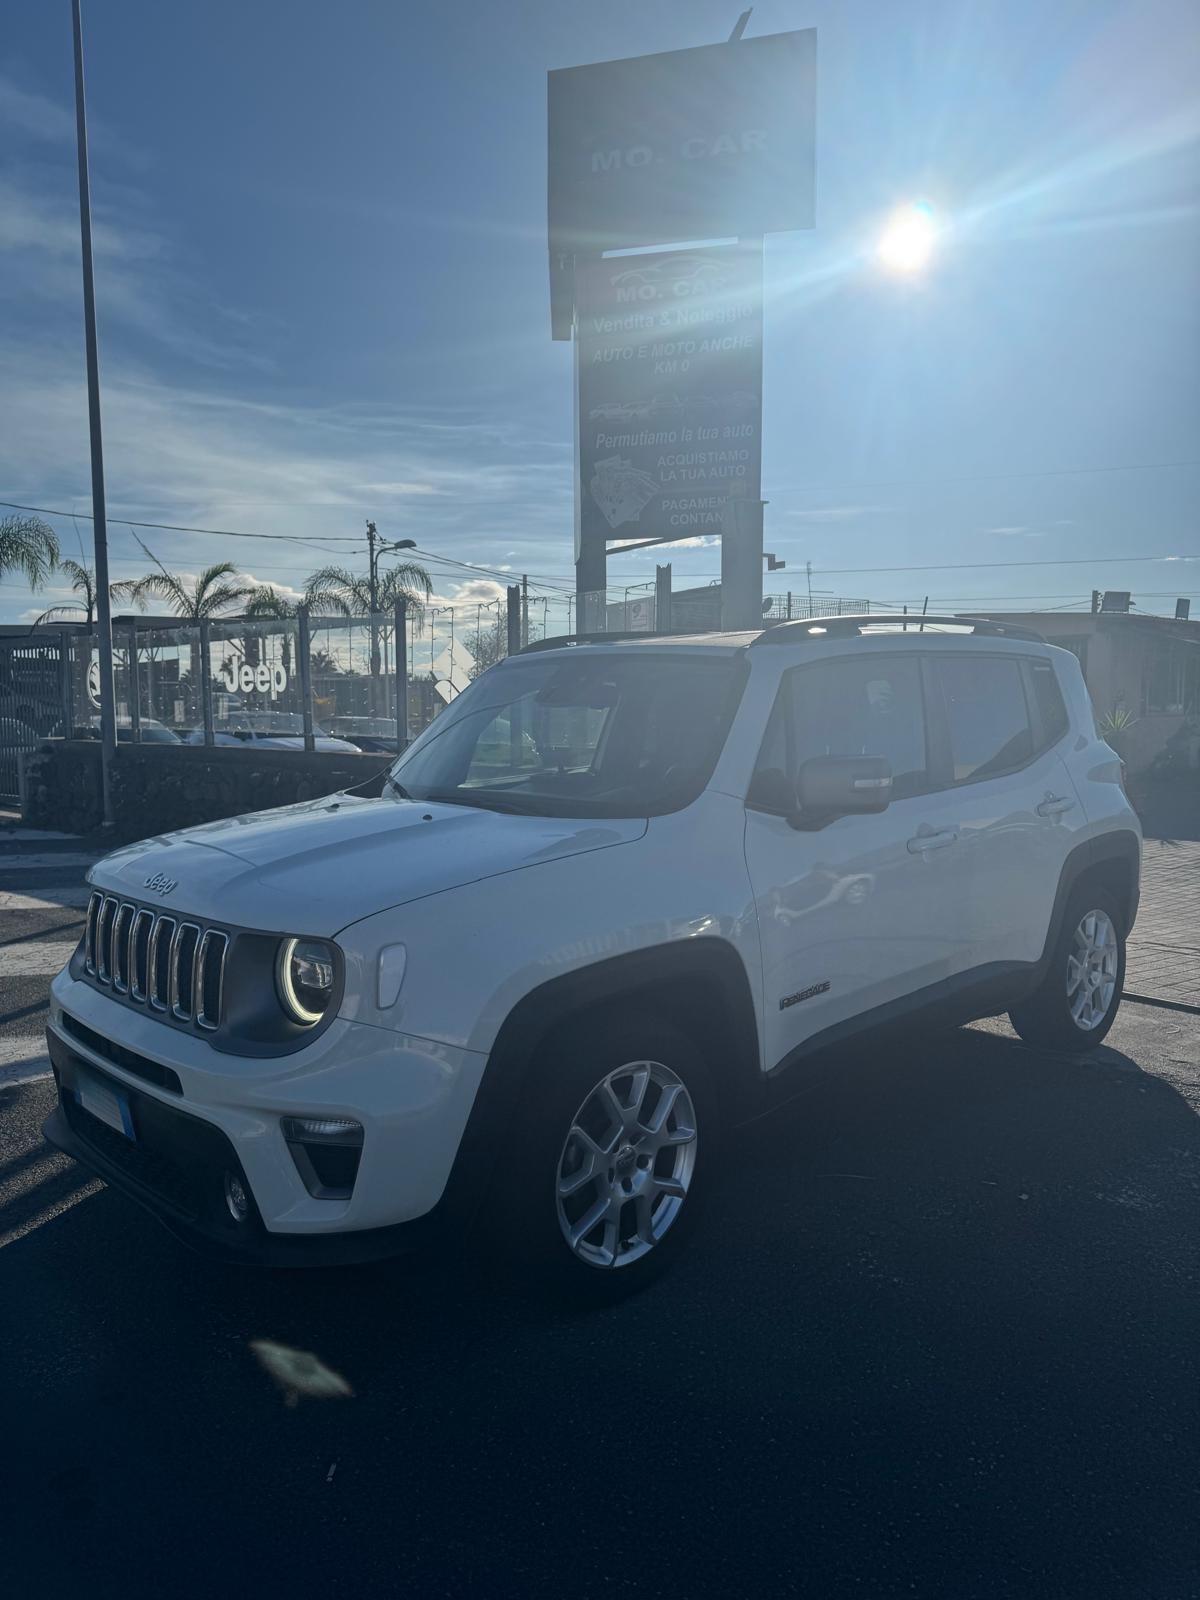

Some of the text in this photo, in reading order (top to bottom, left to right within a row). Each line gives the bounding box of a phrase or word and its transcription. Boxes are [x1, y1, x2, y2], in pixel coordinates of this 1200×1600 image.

[591, 129, 769, 173] MO. CAR
[616, 285, 664, 303] MO.
[593, 303, 753, 333] Vendita & Noleggio
[592, 335, 753, 363] AUTO E MOTO ANCHE
[654, 360, 690, 375] KM 0
[596, 424, 754, 449] Permutiamo la tua auto
[657, 450, 749, 467] ACQUISTIAMO
[660, 465, 746, 482] LA TUA AUTO
[662, 496, 729, 511] PAGAMEN
[670, 512, 724, 525] CONTAN
[224, 655, 287, 701] Jeep
[143, 871, 178, 897] Jeep
